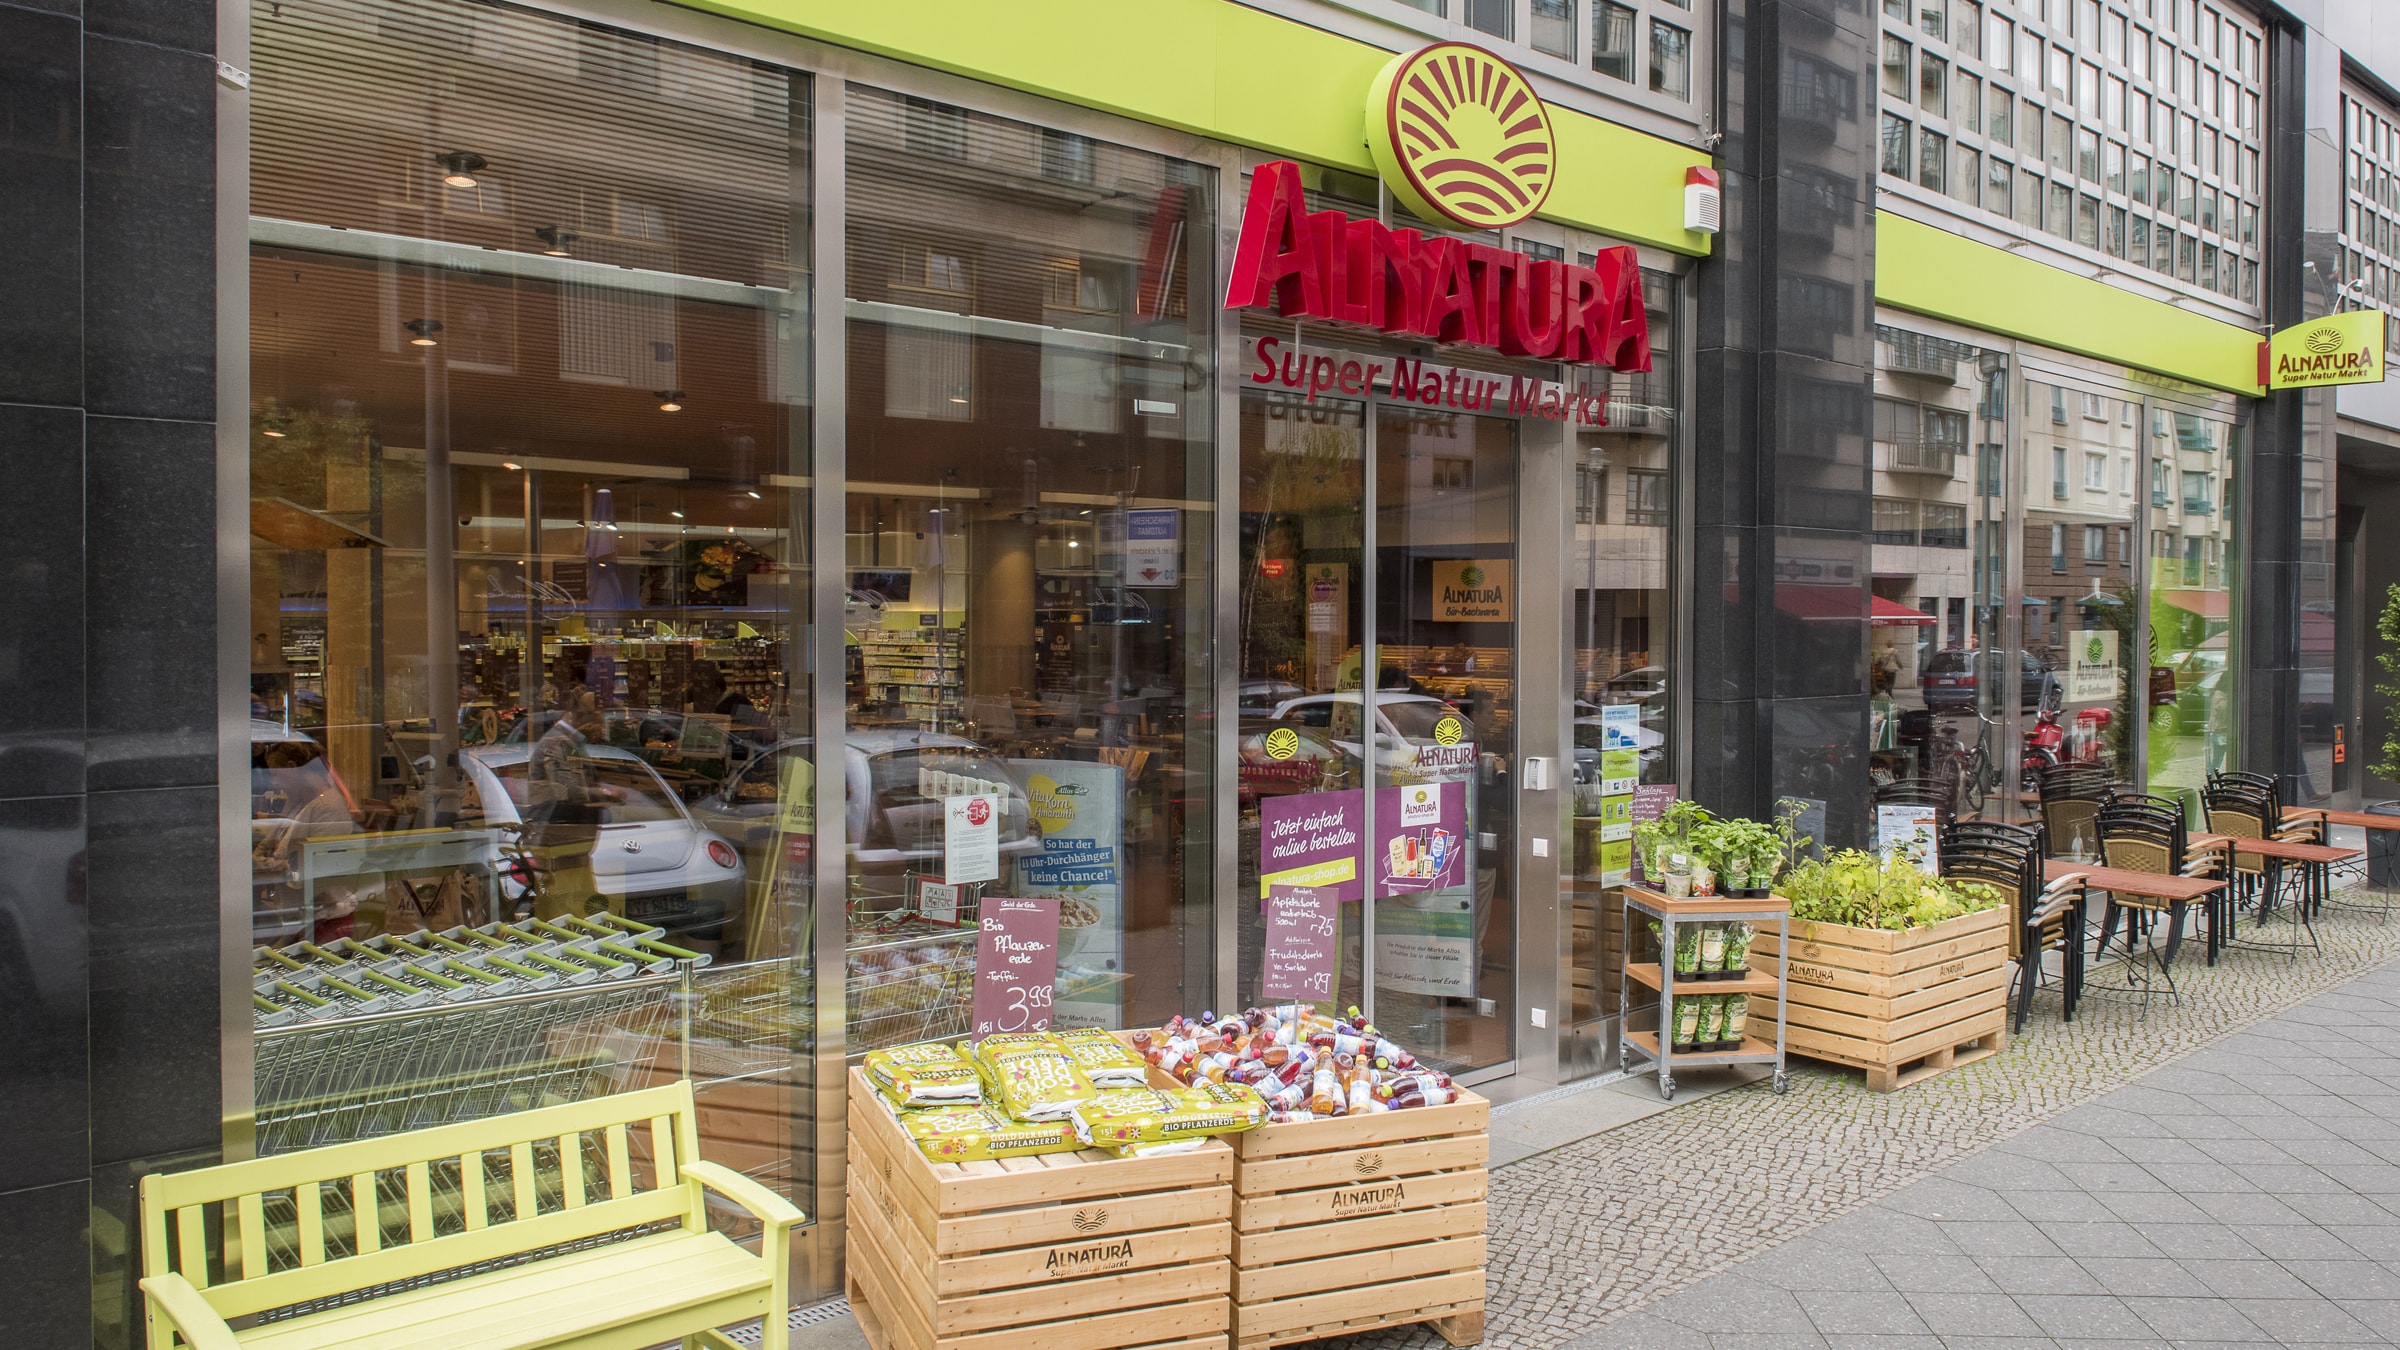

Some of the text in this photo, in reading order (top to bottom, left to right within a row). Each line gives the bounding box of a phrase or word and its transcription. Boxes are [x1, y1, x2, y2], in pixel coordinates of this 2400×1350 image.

[1224, 160, 1653, 373] ALNATURA
[2278, 346, 2373, 374] ALNATURA
[1251, 336, 1611, 427] Super Natur Markt
[2282, 369, 2368, 383] Super Natur Markt
[1443, 585, 1503, 603] ALNATURA
[1338, 678, 1361, 690] ALNAT
[1416, 741, 1479, 768] ALNATURA
[1420, 766, 1477, 778] Super Natur Markt
[1026, 785, 1046, 802] Vita
[1057, 787, 1074, 795] Allos
[1405, 801, 1437, 815] ALNATURA
[1271, 806, 1344, 839] Jetzt einfach
[1046, 840, 1092, 849] So hat der
[1272, 828, 1356, 858] online bestellen
[1030, 851, 1111, 868] Uhr-Durchhänger
[1031, 871, 1058, 882] keine
[982, 917, 1005, 932] Bio
[1008, 953, 1033, 965] erde
[1788, 962, 1834, 981] ALNATURA
[1443, 977, 1460, 985] Erde
[1068, 1014, 1088, 1023] Marke
[1164, 1118, 1235, 1132] BIO PFLANZERDE
[990, 1129, 1061, 1141] GOLD DER ERDE
[990, 1136, 1061, 1149] BIO PFLANZERDE
[1331, 1182, 1405, 1209] ALNATURA
[1335, 1201, 1401, 1217] Super Natur Markt
[1046, 1239, 1133, 1269] ALNATURA
